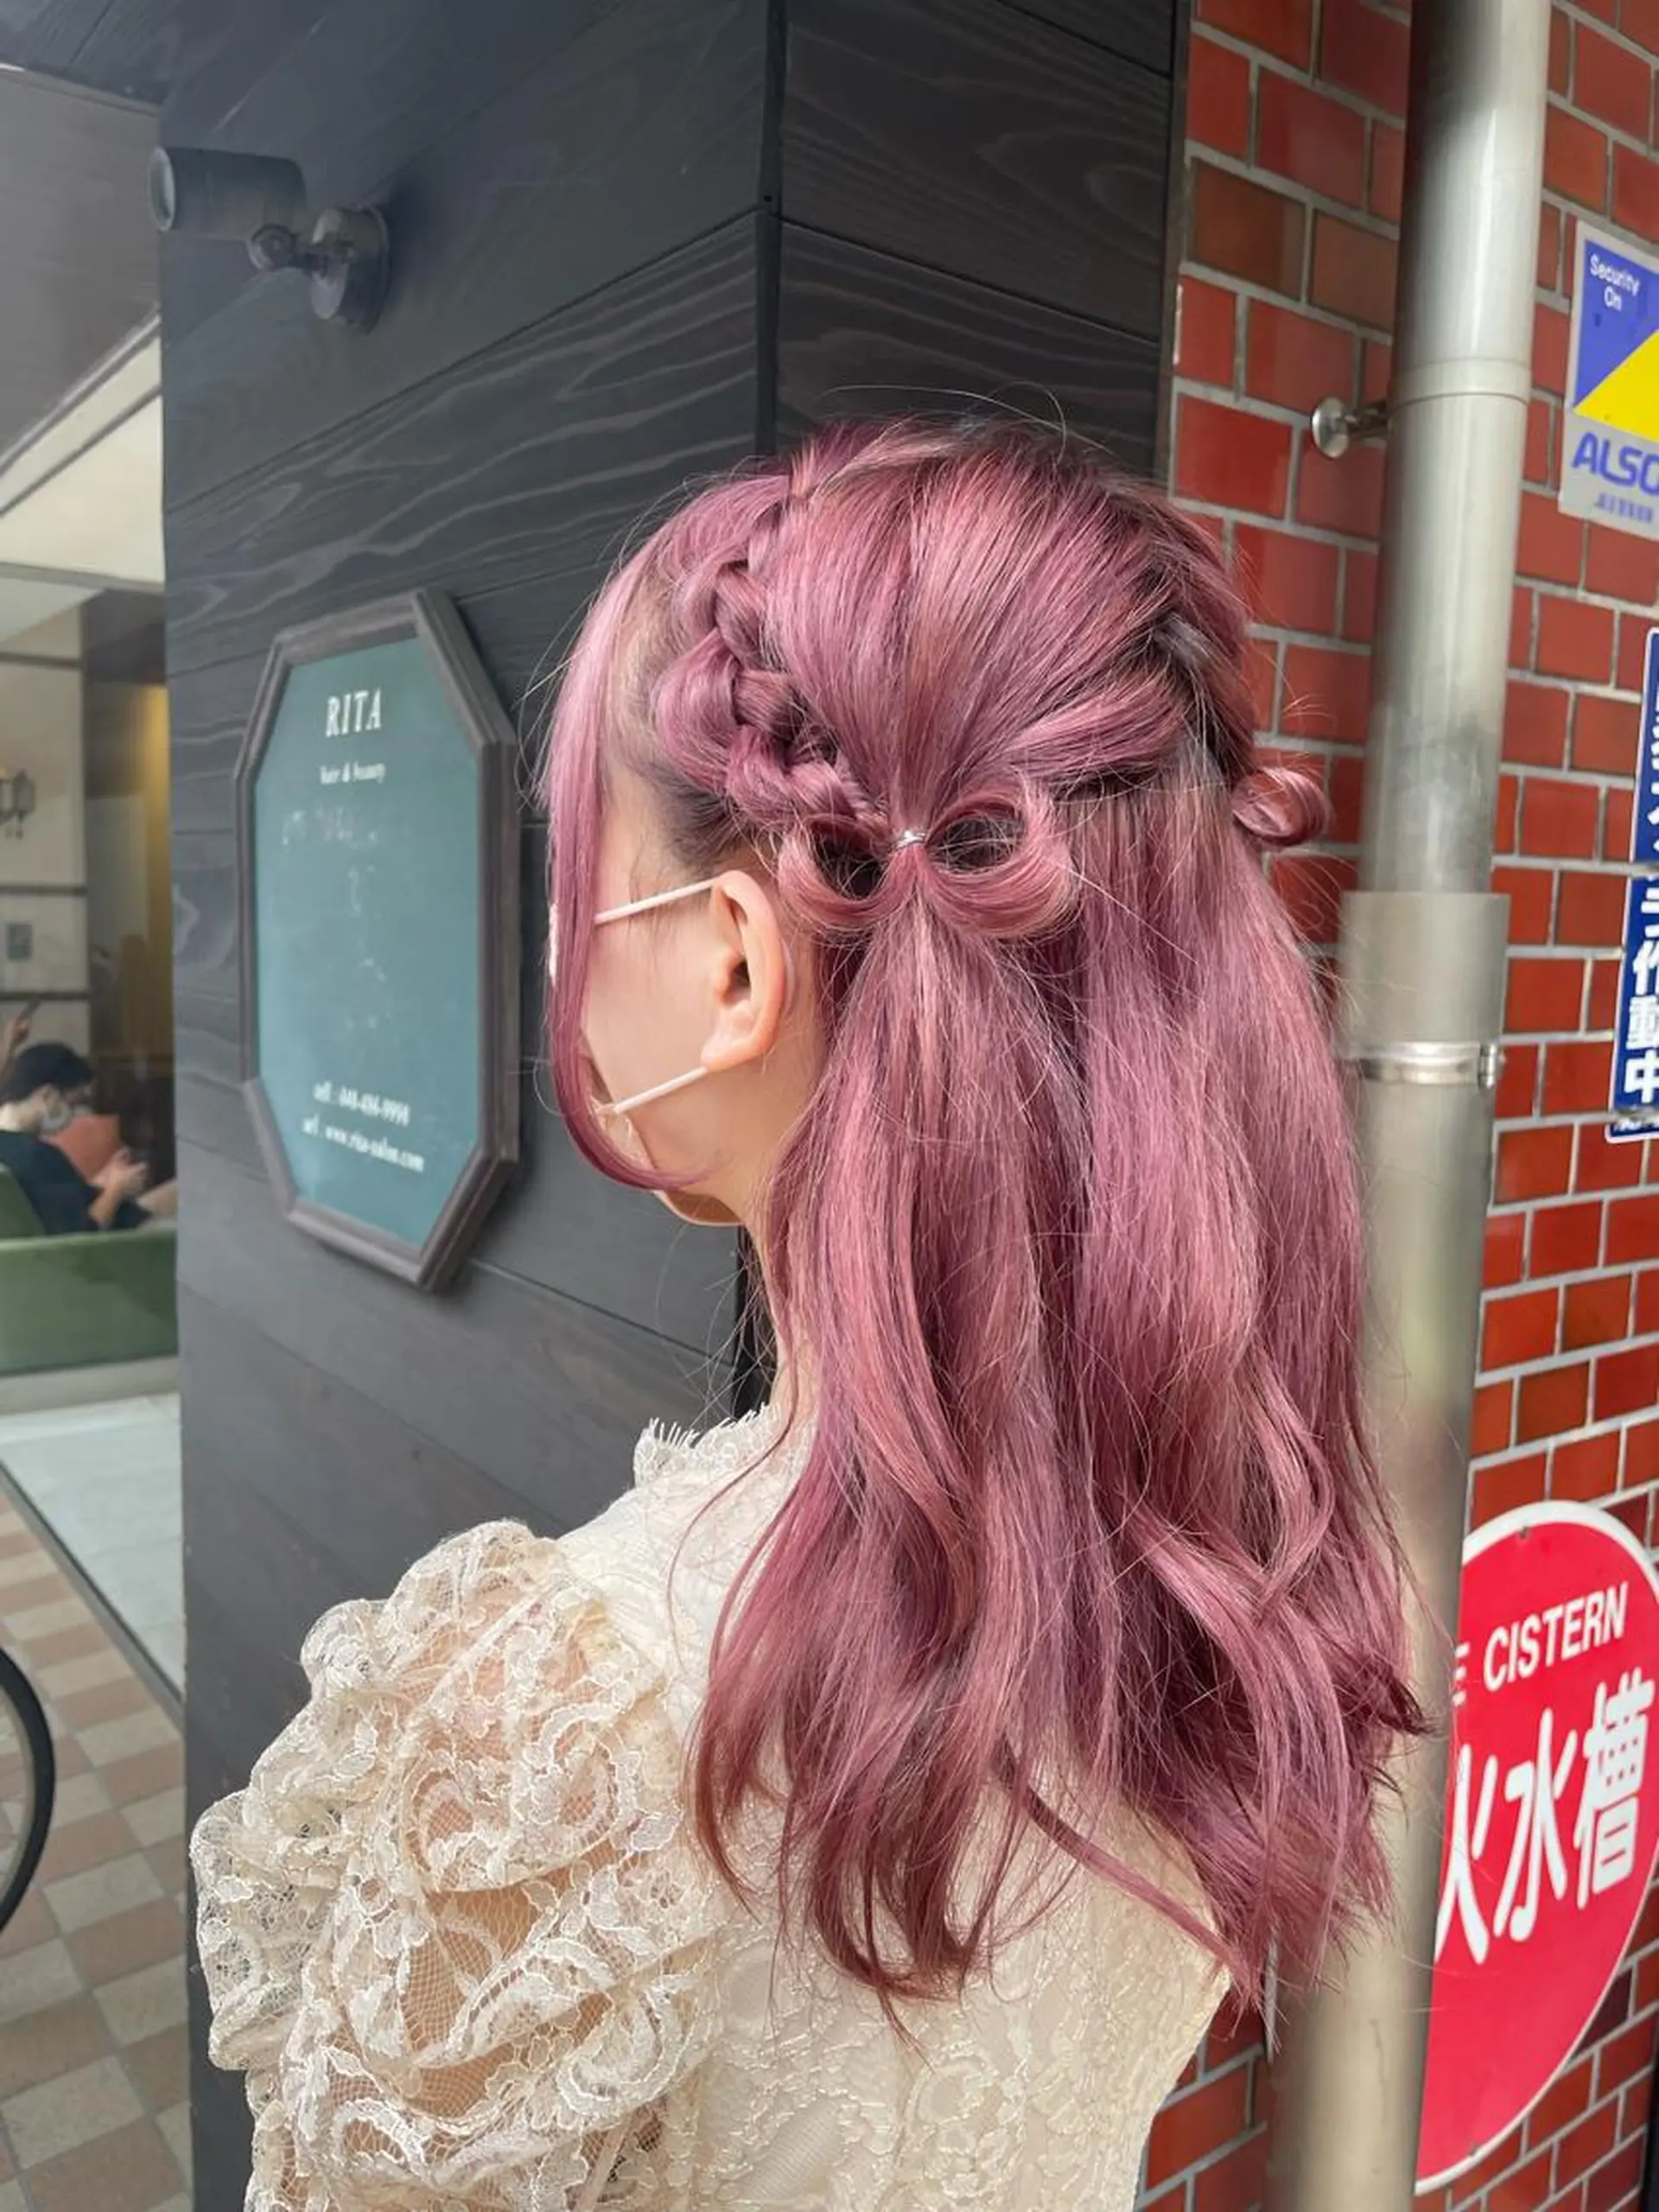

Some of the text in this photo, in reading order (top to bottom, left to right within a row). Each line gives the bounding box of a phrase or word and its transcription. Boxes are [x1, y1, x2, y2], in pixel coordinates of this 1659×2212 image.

[1590, 254, 1640, 296] Security
[1604, 286, 1622, 311] On
[326, 689, 382, 736] RITA
[1483, 1580, 1629, 1693] CISTERN
